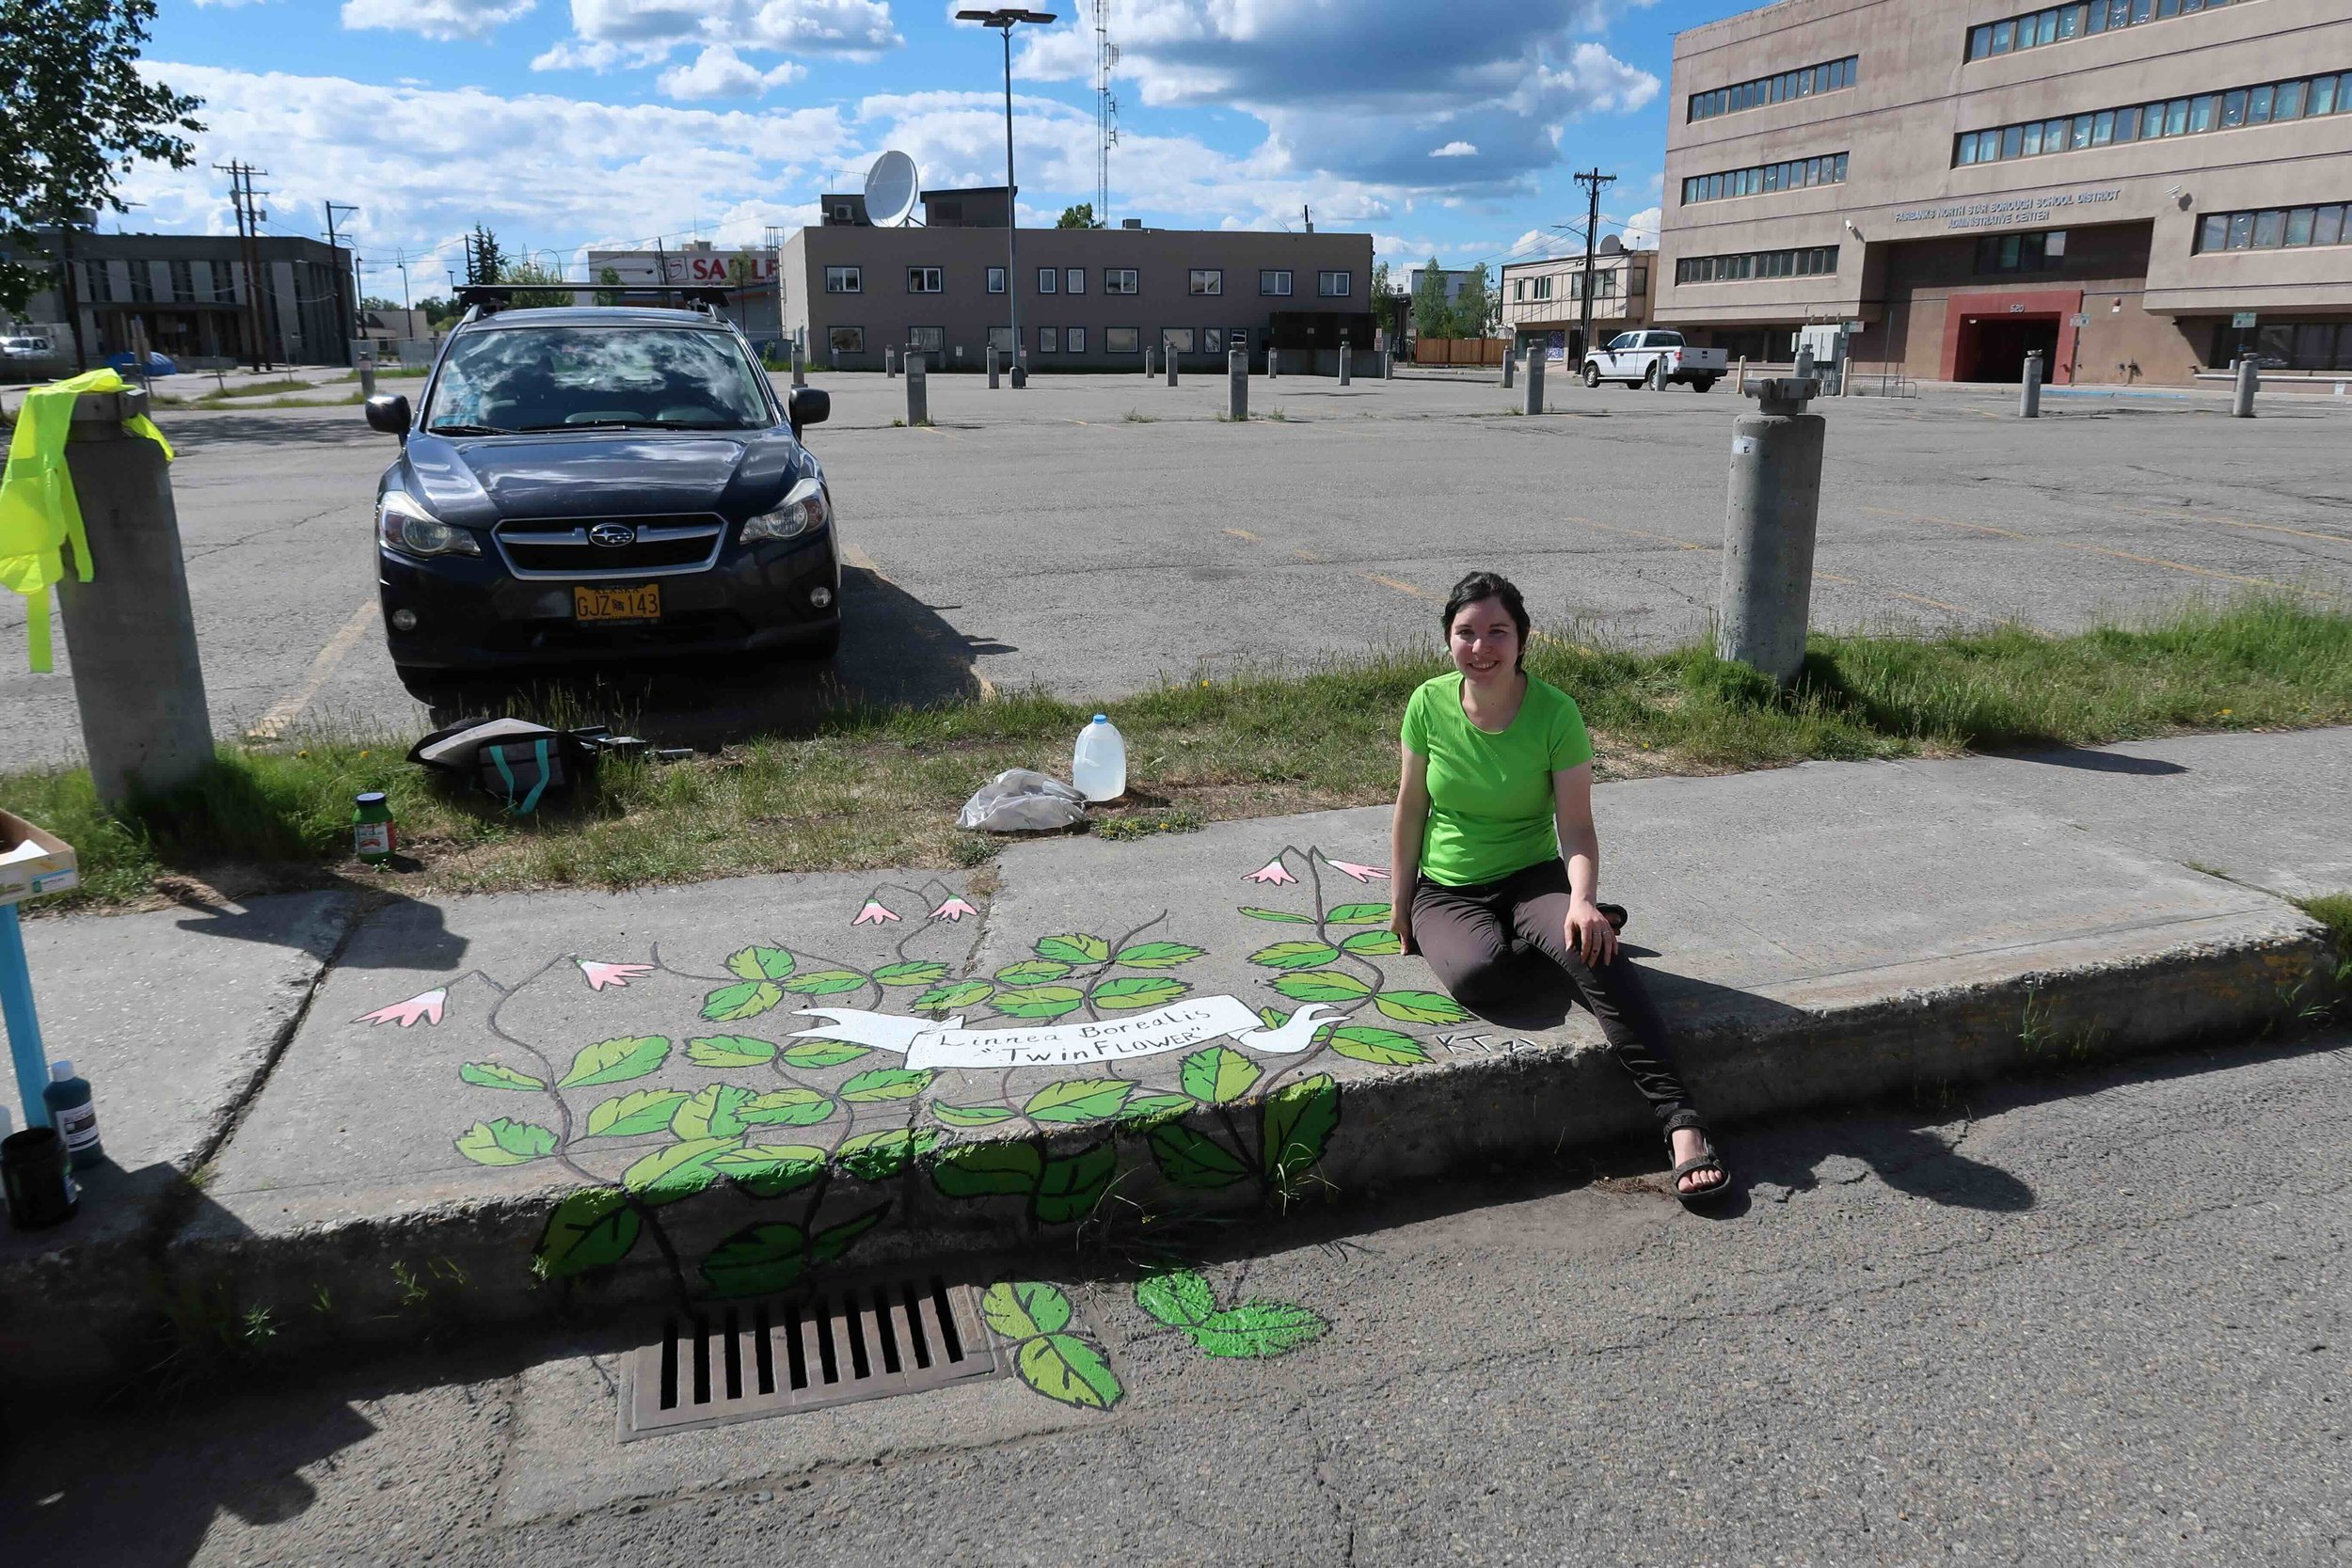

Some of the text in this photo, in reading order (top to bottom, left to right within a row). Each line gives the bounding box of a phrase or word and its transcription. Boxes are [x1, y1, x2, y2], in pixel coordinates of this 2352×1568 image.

[1895, 189, 2121, 222] FAIRBANKS NORTH STAR BOROUGH SCHOOL DISTRICT
[1947, 211, 2049, 229] ADMINISTRATIVE CENTER
[577, 593, 659, 617] GJZ 143
[939, 1009, 1211, 1046] Linnea Borealis
